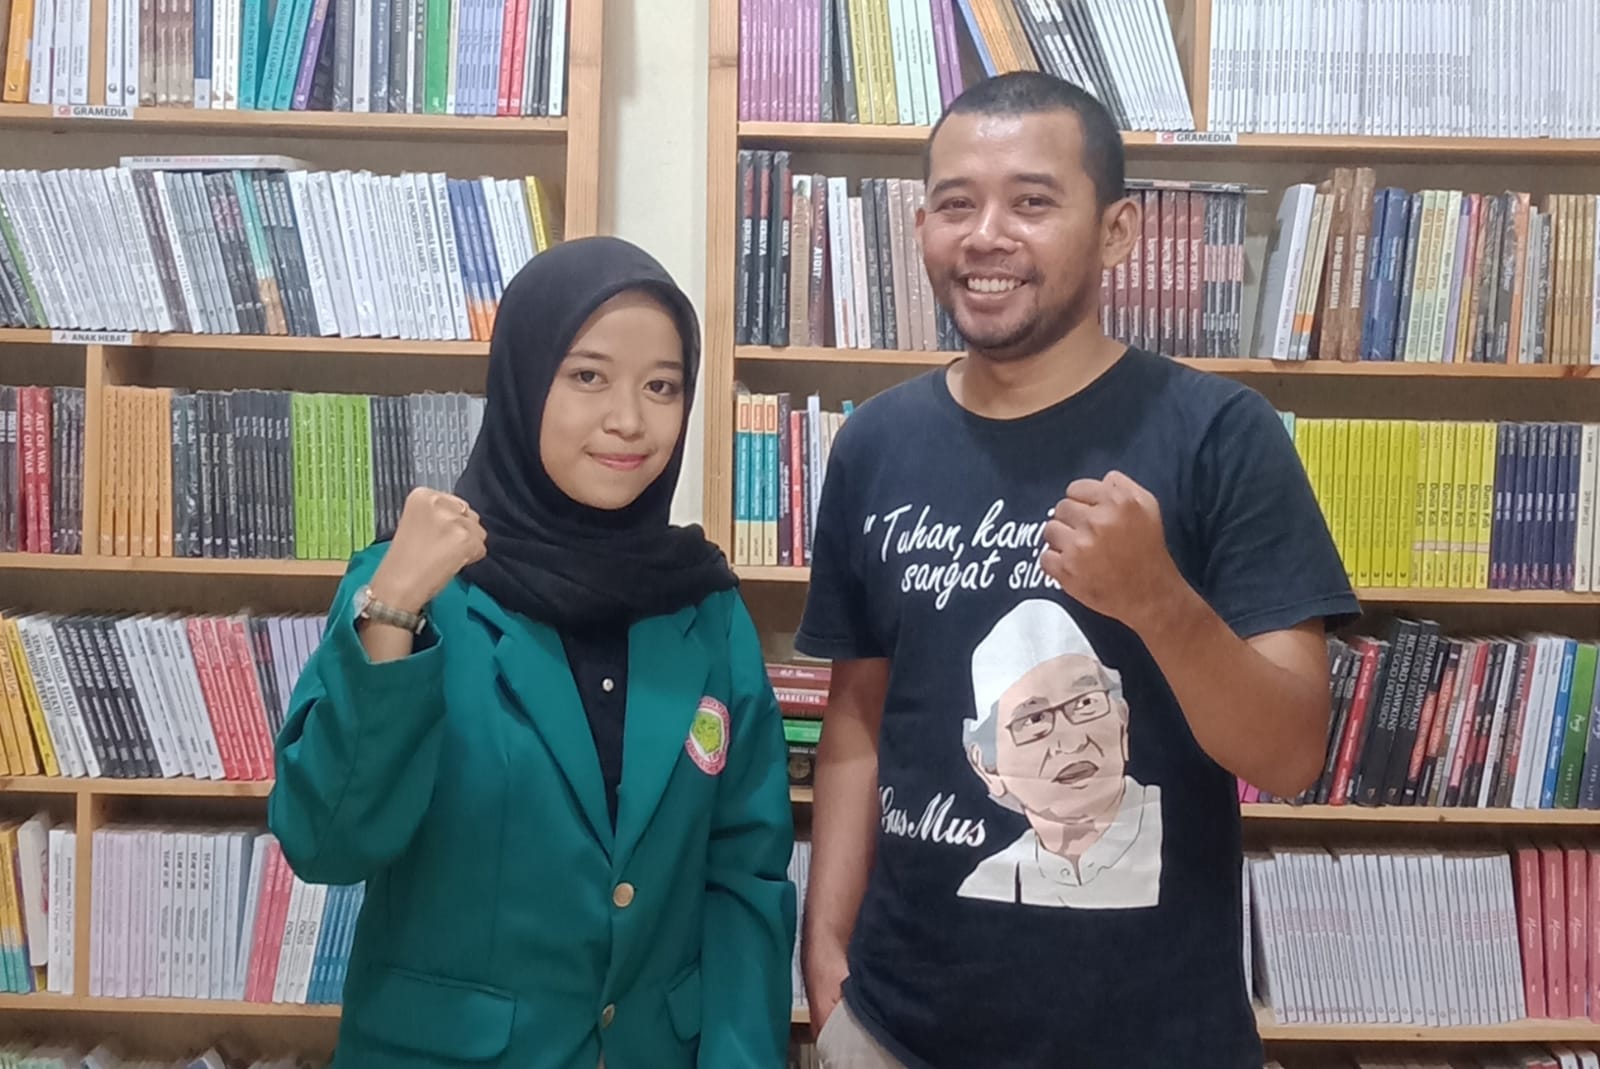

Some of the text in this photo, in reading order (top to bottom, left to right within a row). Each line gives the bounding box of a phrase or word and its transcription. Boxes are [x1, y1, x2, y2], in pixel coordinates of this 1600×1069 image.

[73, 106, 129, 117] GRAMEDIA
[1176, 133, 1232, 143] GRAMEDIA
[405, 186, 414, 200] THE
[415, 245, 428, 272] HABITS
[418, 186, 427, 201] THE
[428, 246, 440, 273] HABITS
[437, 187, 446, 200] THE
[446, 246, 457, 272] HABITS
[72, 333, 126, 343] ANAK HEBAT
[23, 412, 34, 474] ART OF WAR
[35, 412, 46, 474] ART OF WAR
[1415, 482, 1425, 508] Dunia
[1428, 482, 1437, 508] Dunia
[1441, 482, 1450, 508] Dunia
[1455, 483, 1465, 509] Dunia
[1468, 483, 1478, 509] Dunia
[1482, 484, 1492, 510] Dunia
[901, 543, 1062, 610] sangat sibu
[19, 628, 52, 712] SENI HIDUP EFEKTIF
[30, 633, 63, 718] SENI HIDUP EFEKTIF
[44, 634, 78, 719] SENI HIDUP EFEKTIF
[1377, 633, 1406, 729] THE GOD DELUSION
[1387, 634, 1417, 731] RICHARD DAWKINS
[1399, 632, 1428, 729] THE GOD DELUSION
[1408, 634, 1438, 731] RICHARD DAWKINS
[778, 693, 820, 704] ARKETING
[907, 792, 986, 847] Mus
[283, 920, 293, 946] FOKUS
[296, 919, 307, 945] FOKUS
[306, 920, 317, 946] FOKUS
